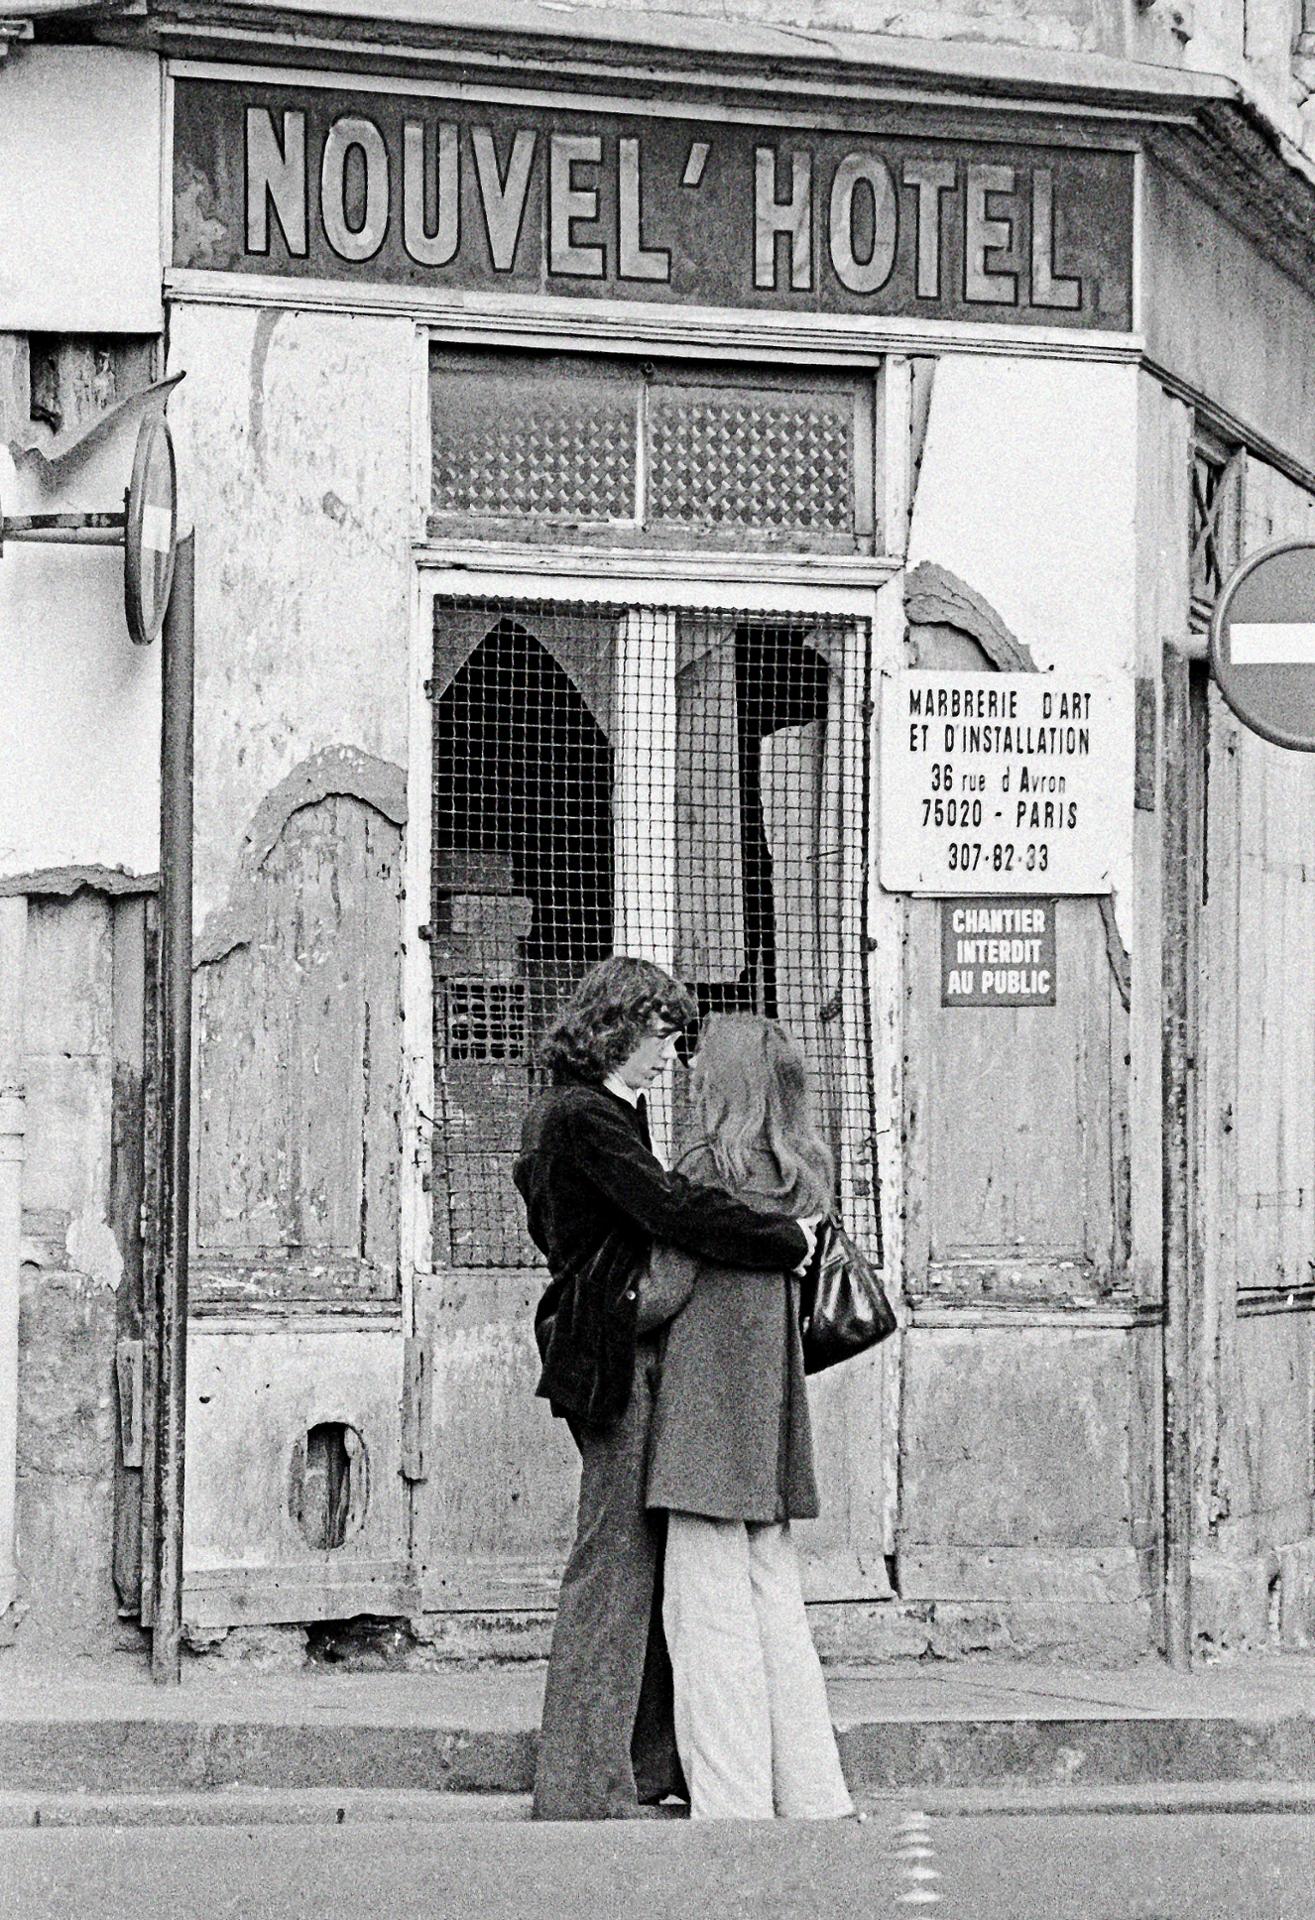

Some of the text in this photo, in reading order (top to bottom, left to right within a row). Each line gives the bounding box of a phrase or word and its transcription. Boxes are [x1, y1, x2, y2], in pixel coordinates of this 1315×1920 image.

[752, 145, 1083, 311] HOTEL
[909, 689, 1092, 720] MARBRERIE D'ART
[909, 724, 1090, 755] ET D'INSTALLATION
[931, 763, 953, 792] 36
[961, 772, 986, 792] rue
[921, 798, 982, 828] 75020
[1016, 801, 1078, 829] PARIS
[952, 907, 1046, 934] CHANTIER
[956, 939, 1042, 964] INTERDIT
[947, 969, 1051, 996] AU PUBLIC
